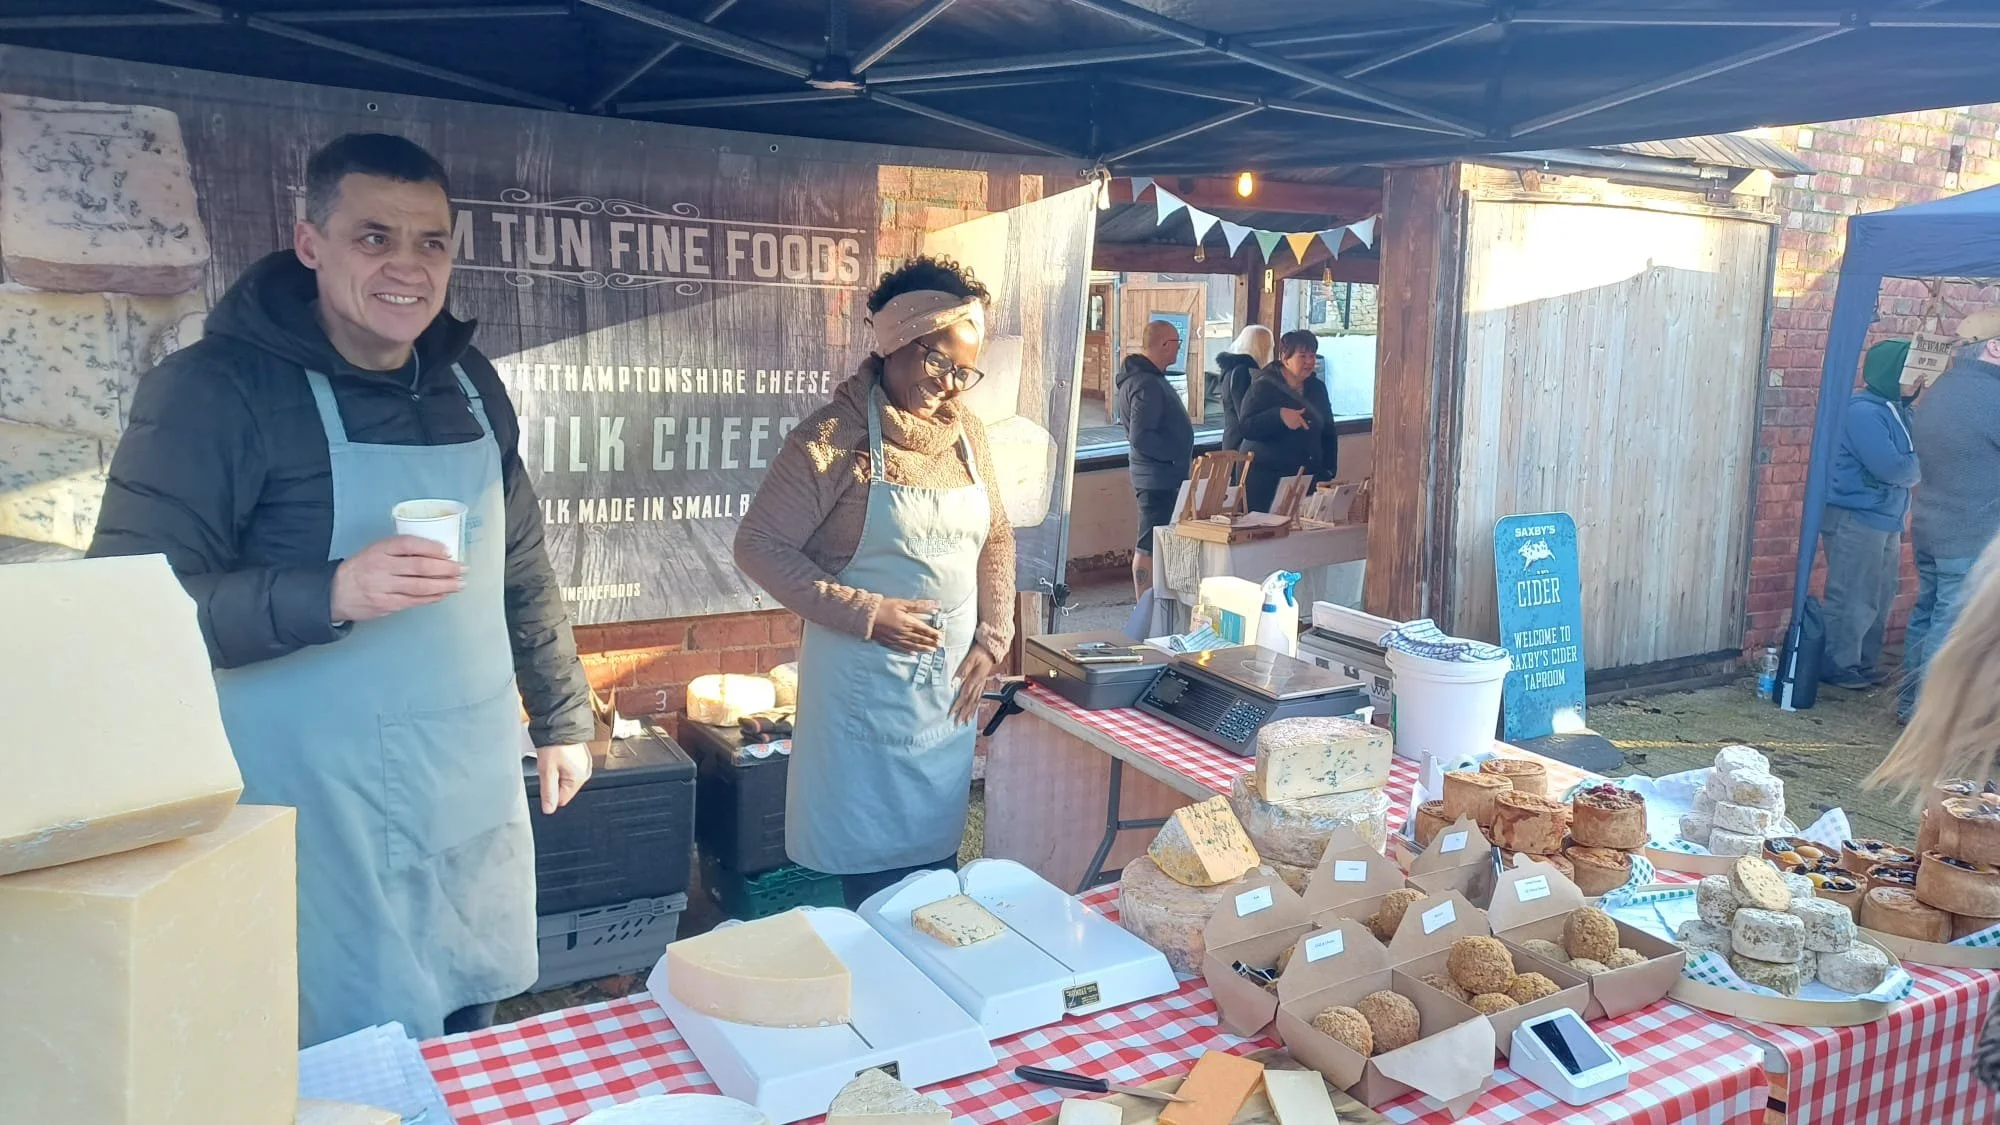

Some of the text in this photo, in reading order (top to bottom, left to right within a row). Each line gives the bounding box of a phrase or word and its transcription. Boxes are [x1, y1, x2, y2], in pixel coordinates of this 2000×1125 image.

[492, 213, 592, 267] TUN
[609, 221, 710, 275] FINE
[726, 230, 861, 282] FOODS
[497, 362, 831, 394] NORTHAMPTONSHIRE CHEESE
[538, 498, 571, 525] LK
[578, 497, 636, 524] MADE
[643, 496, 665, 521] IN
[671, 493, 733, 520] SMALL
[1514, 525, 1556, 538] SAXBY'S
[1517, 577, 1561, 608] CIDER
[1513, 625, 1571, 649] WELCOME TO
[1510, 645, 1578, 672] SAXBY'S CIDER
[1524, 668, 1566, 691] TAPROOM
[655, 690, 666, 711] 3
